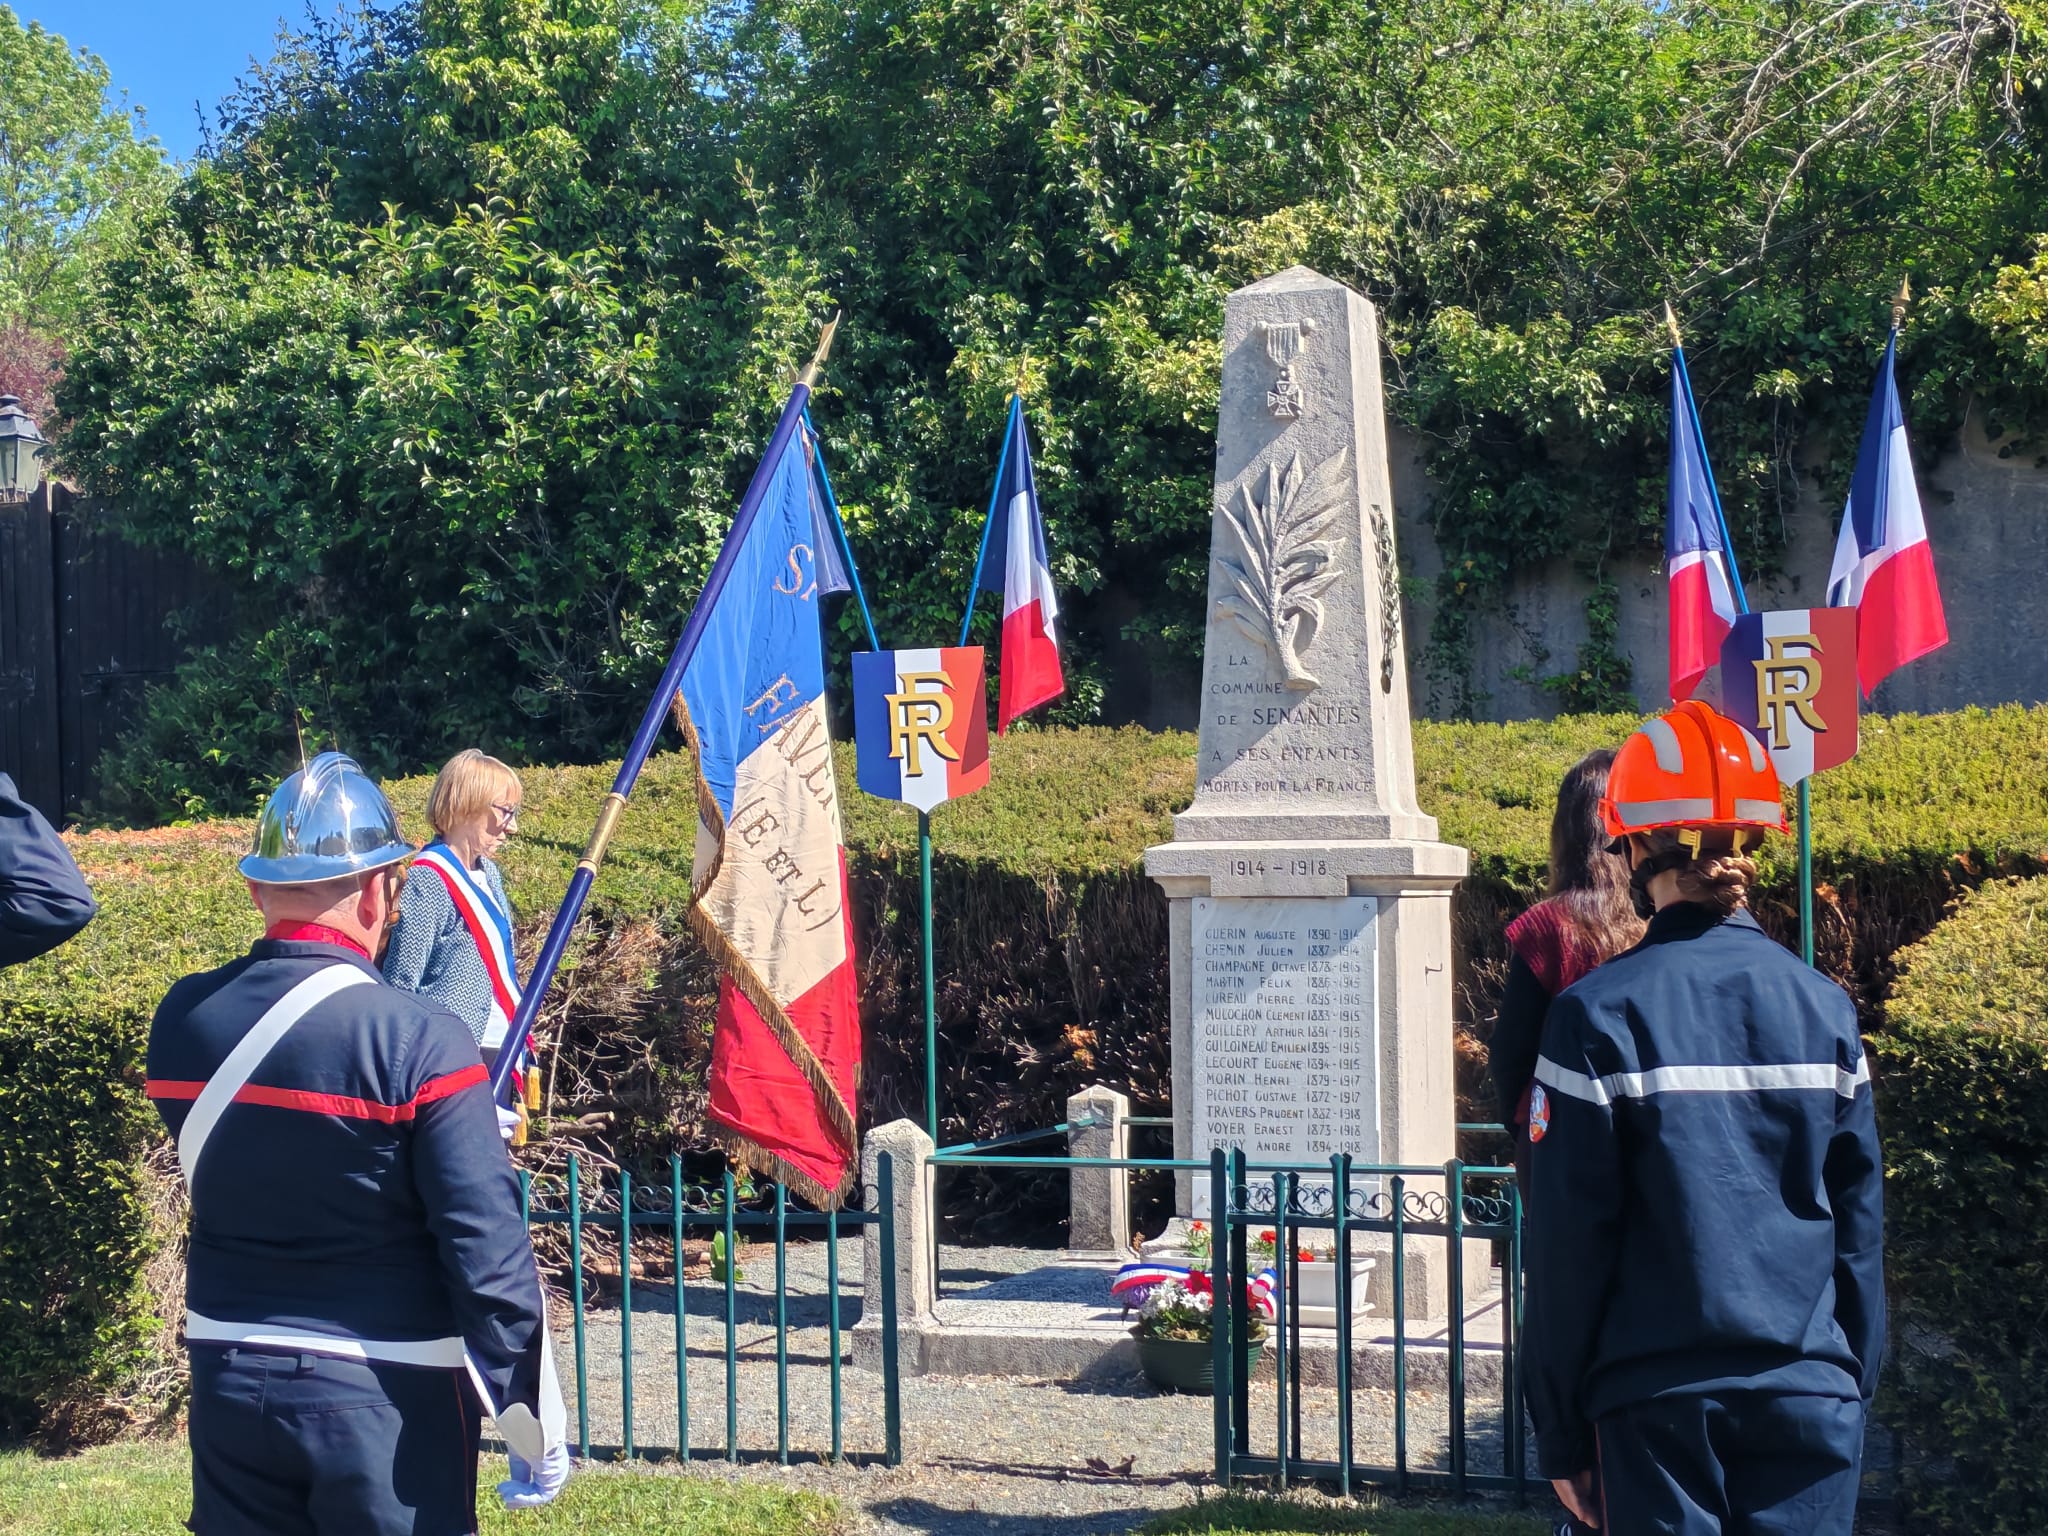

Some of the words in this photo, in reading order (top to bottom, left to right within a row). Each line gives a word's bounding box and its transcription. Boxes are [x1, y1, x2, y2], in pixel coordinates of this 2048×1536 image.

[1229, 655, 1248, 666] LA
[1210, 682, 1283, 694] COMMUNE
[1217, 715, 1238, 725] DE
[1252, 707, 1360, 725] SENANTES
[1212, 750, 1222, 761] A
[1235, 748, 1269, 761] SES
[1281, 747, 1361, 761] ENFANTS
[1201, 779, 1248, 792] MORTS
[1254, 780, 1287, 792] POUR
[1293, 780, 1311, 792] LA
[1315, 778, 1373, 792] FRANCE
[1230, 860, 1265, 876] 1914
[1290, 860, 1327, 876] 1918
[1254, 930, 1296, 940] AUGUSTE
[1206, 944, 1245, 956] CHEMIN
[1257, 944, 1293, 956] JULIEN
[1206, 961, 1264, 972] CHAMPAGNE
[1272, 961, 1306, 972] OCTAVE
[1206, 976, 1244, 988] MARTIN
[1260, 976, 1291, 988] FELIX
[1257, 993, 1295, 1004] PIERRE
[1206, 1008, 1262, 1020] MULOCHON
[1206, 1024, 1256, 1037] GUILLERY
[1266, 1027, 1304, 1037] ARTHUR
[1206, 1040, 1267, 1053] GUILOINEAU
[1272, 1041, 1306, 1053] EMILIEN
[1206, 1056, 1258, 1069] LECOURT
[1206, 1073, 1246, 1085] MORIN
[1254, 1074, 1289, 1085] HENRI
[1206, 1088, 1248, 1101] PICHOT
[1256, 1090, 1296, 1102] GUSTAVE
[1207, 1106, 1256, 1118] TRAVERS
[1260, 1106, 1304, 1118] PRUDENT
[1208, 1122, 1246, 1135] VOYER
[1254, 1122, 1294, 1135] ERNEST
[1256, 1141, 1292, 1152] ANDRE
